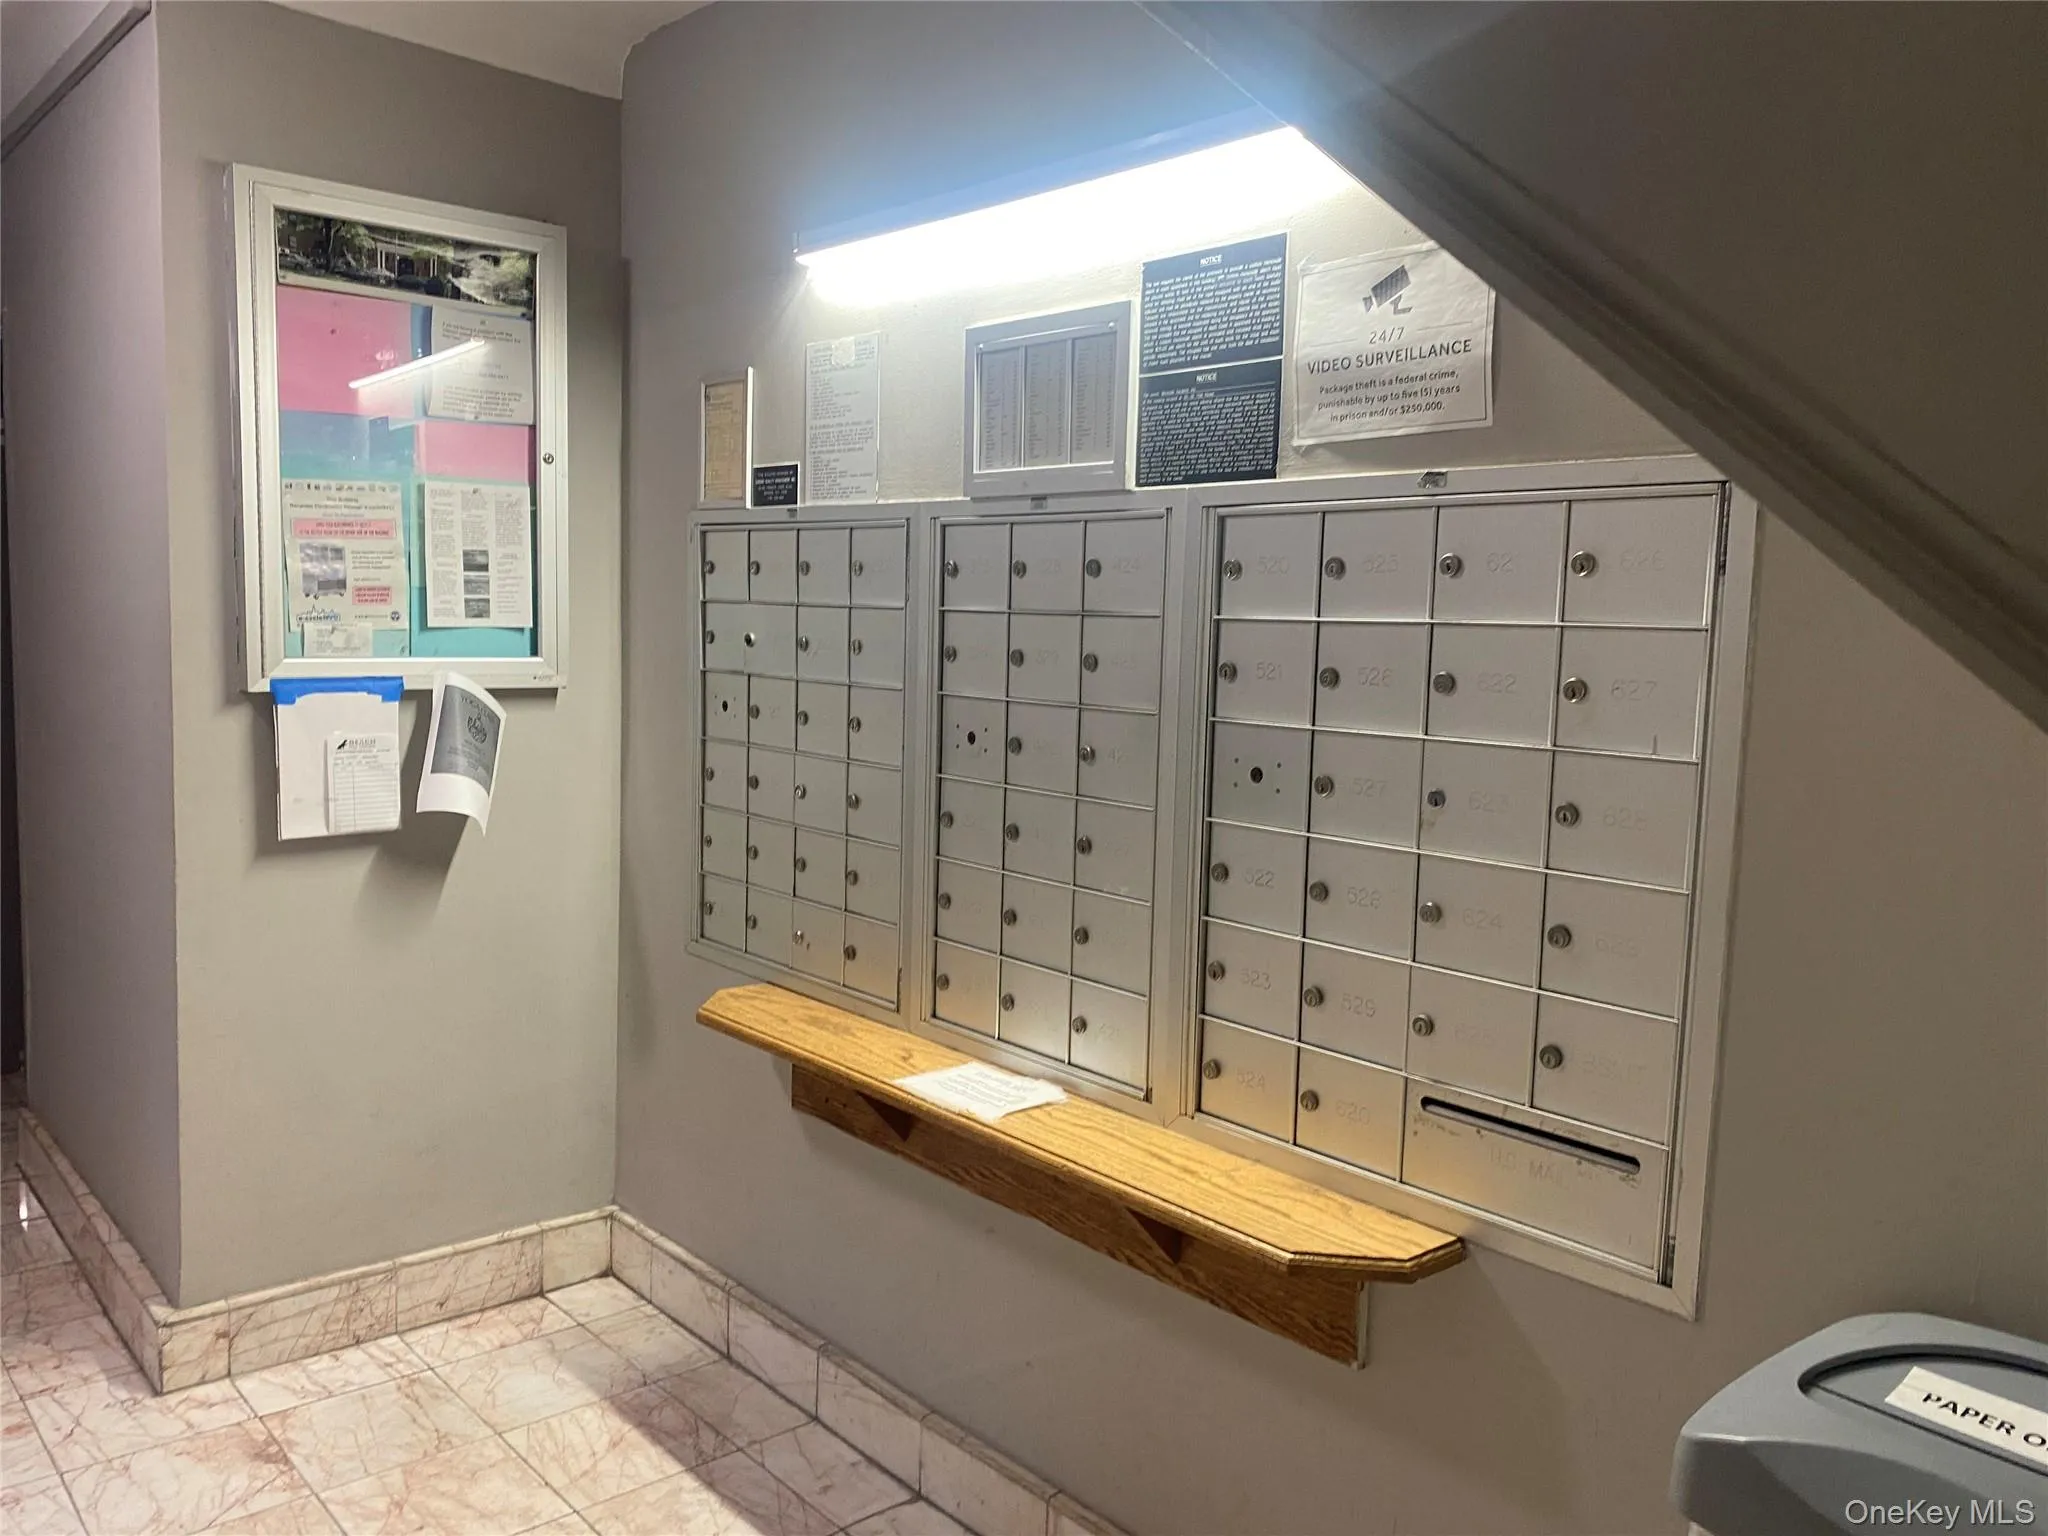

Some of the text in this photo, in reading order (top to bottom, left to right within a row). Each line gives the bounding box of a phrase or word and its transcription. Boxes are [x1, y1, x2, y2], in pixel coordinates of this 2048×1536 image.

[1199, 254, 1223, 266] NOTICE
[1369, 327, 1405, 345] 24/7
[1307, 338, 1474, 376] VIDEO SURVEILLANCE
[1195, 372, 1218, 384] NOTICE
[1319, 369, 1460, 395] Package theft is a federal crime,
[1317, 385, 1461, 412] punishable by up to five (5) years
[1330, 400, 1447, 423] in prison and/or $250,000.
[1256, 555, 1291, 575] 520
[1255, 661, 1284, 682] 521
[1356, 666, 1394, 689] 526
[1610, 678, 1658, 702] 627
[1352, 777, 1388, 798] 527
[1244, 868, 1276, 890] 522
[1461, 906, 1504, 931] 624
[1240, 967, 1273, 991] 523
[1236, 1066, 1266, 1093] 524
[1922, 1392, 2048, 1452] PAPER O
